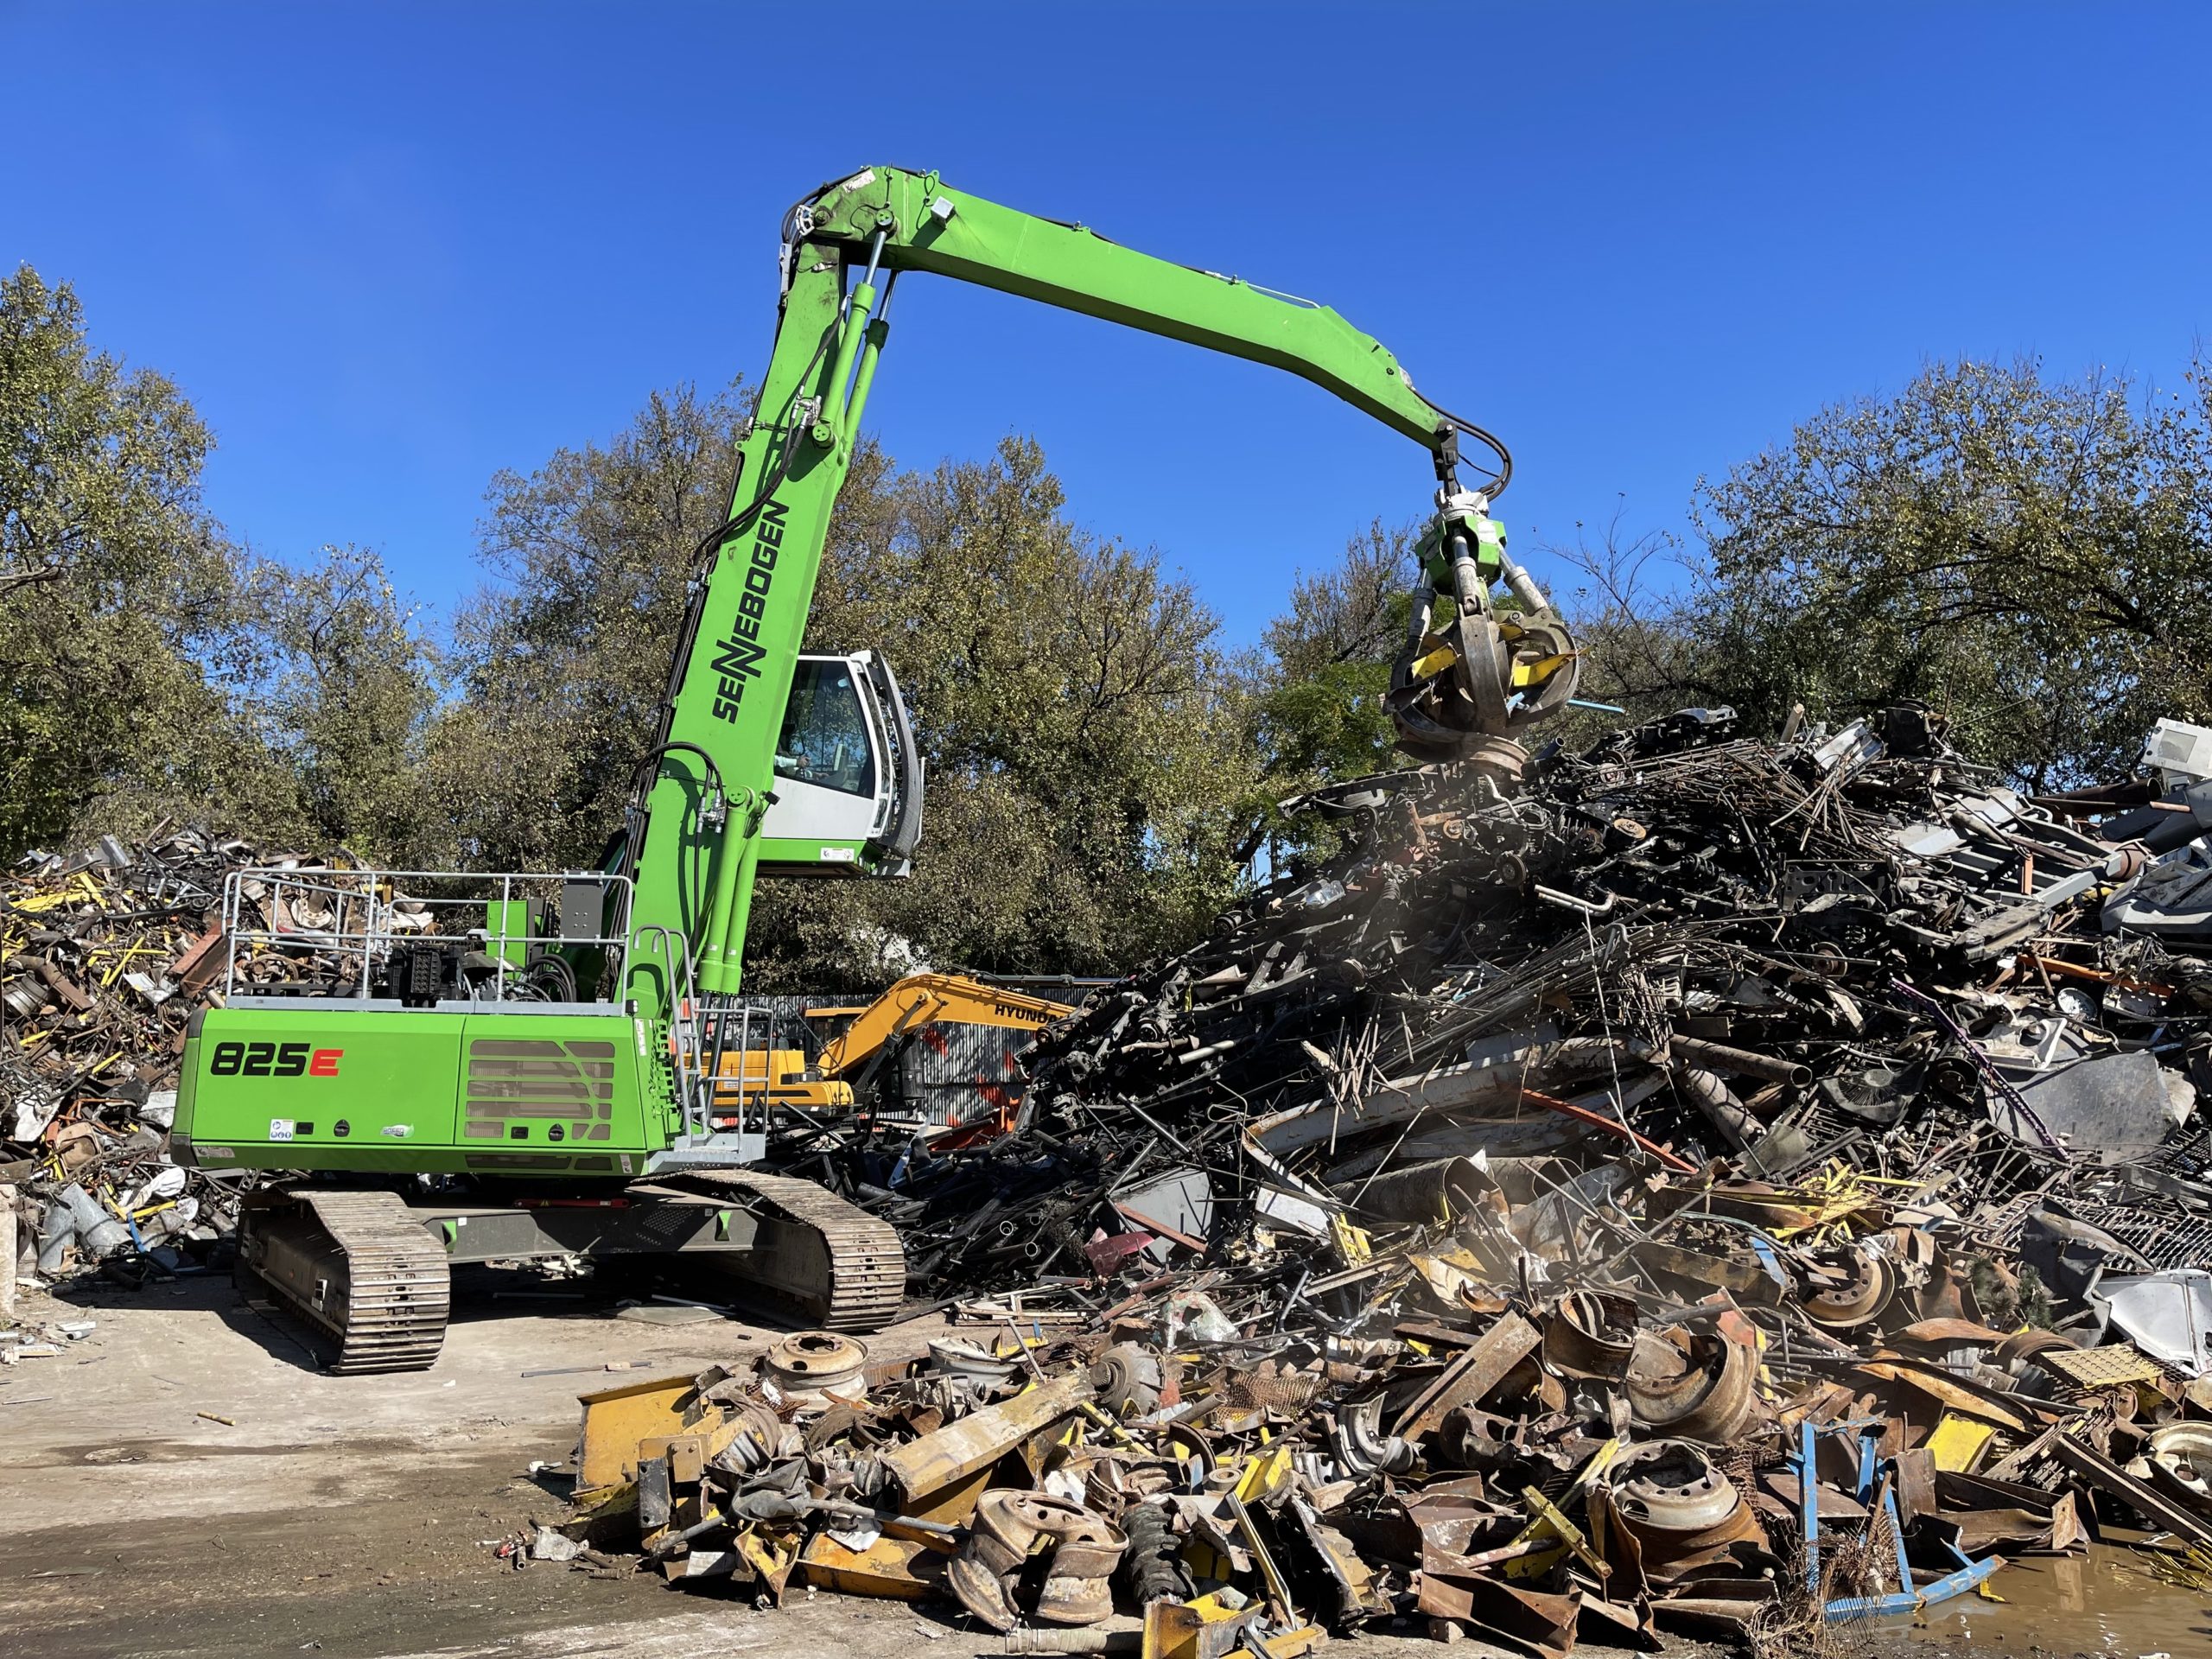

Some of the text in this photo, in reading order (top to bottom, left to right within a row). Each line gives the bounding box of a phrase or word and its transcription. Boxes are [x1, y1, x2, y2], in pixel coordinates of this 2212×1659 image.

[710, 499, 789, 724] SENNEBOGEN
[995, 1004, 1065, 1024] HYUNDA
[211, 1042, 344, 1077] 825E
